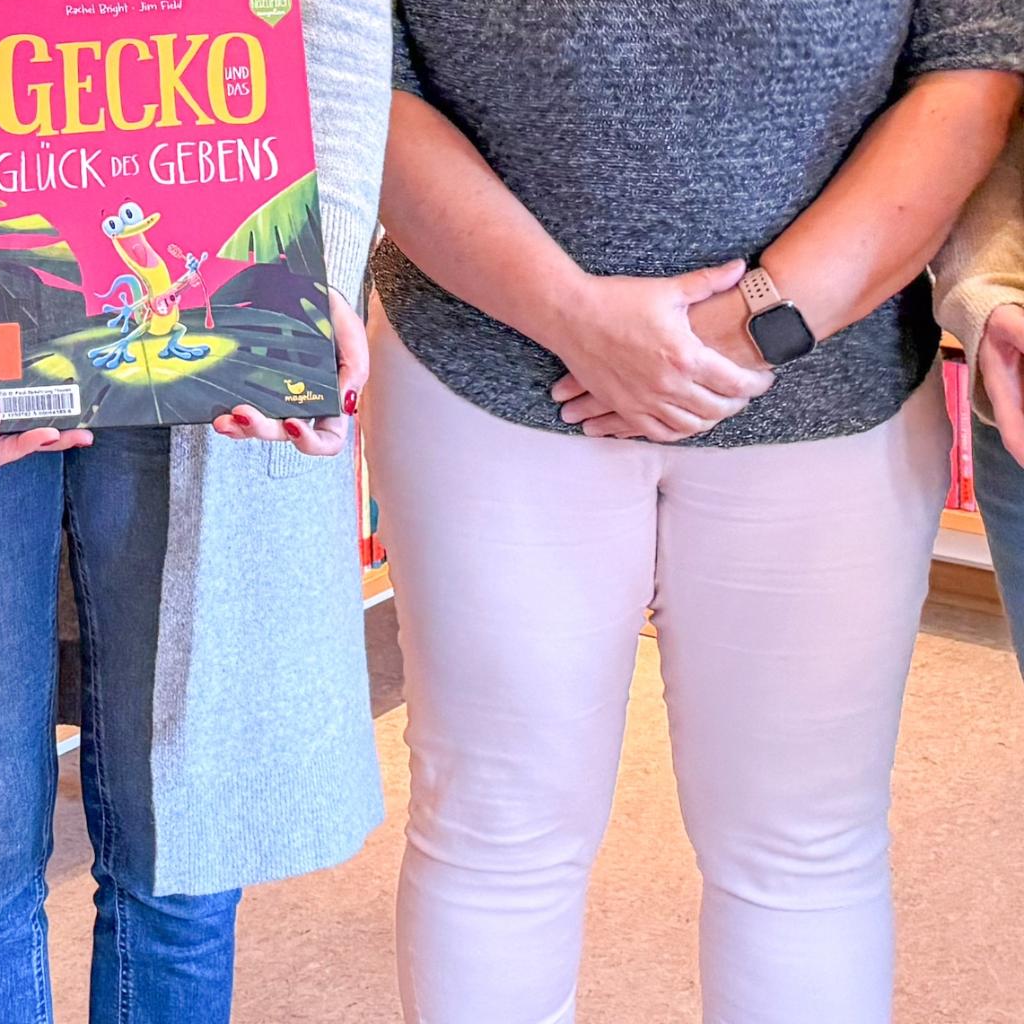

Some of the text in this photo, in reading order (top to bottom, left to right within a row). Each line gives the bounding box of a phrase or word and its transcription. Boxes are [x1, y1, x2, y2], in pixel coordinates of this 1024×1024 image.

[65, 0, 183, 18] Rachel Bright Jim Field
[223, 65, 250, 81] UND
[226, 82, 251, 97] DAS
[111, 153, 141, 178] DES
[149, 136, 280, 186] GEBENS
